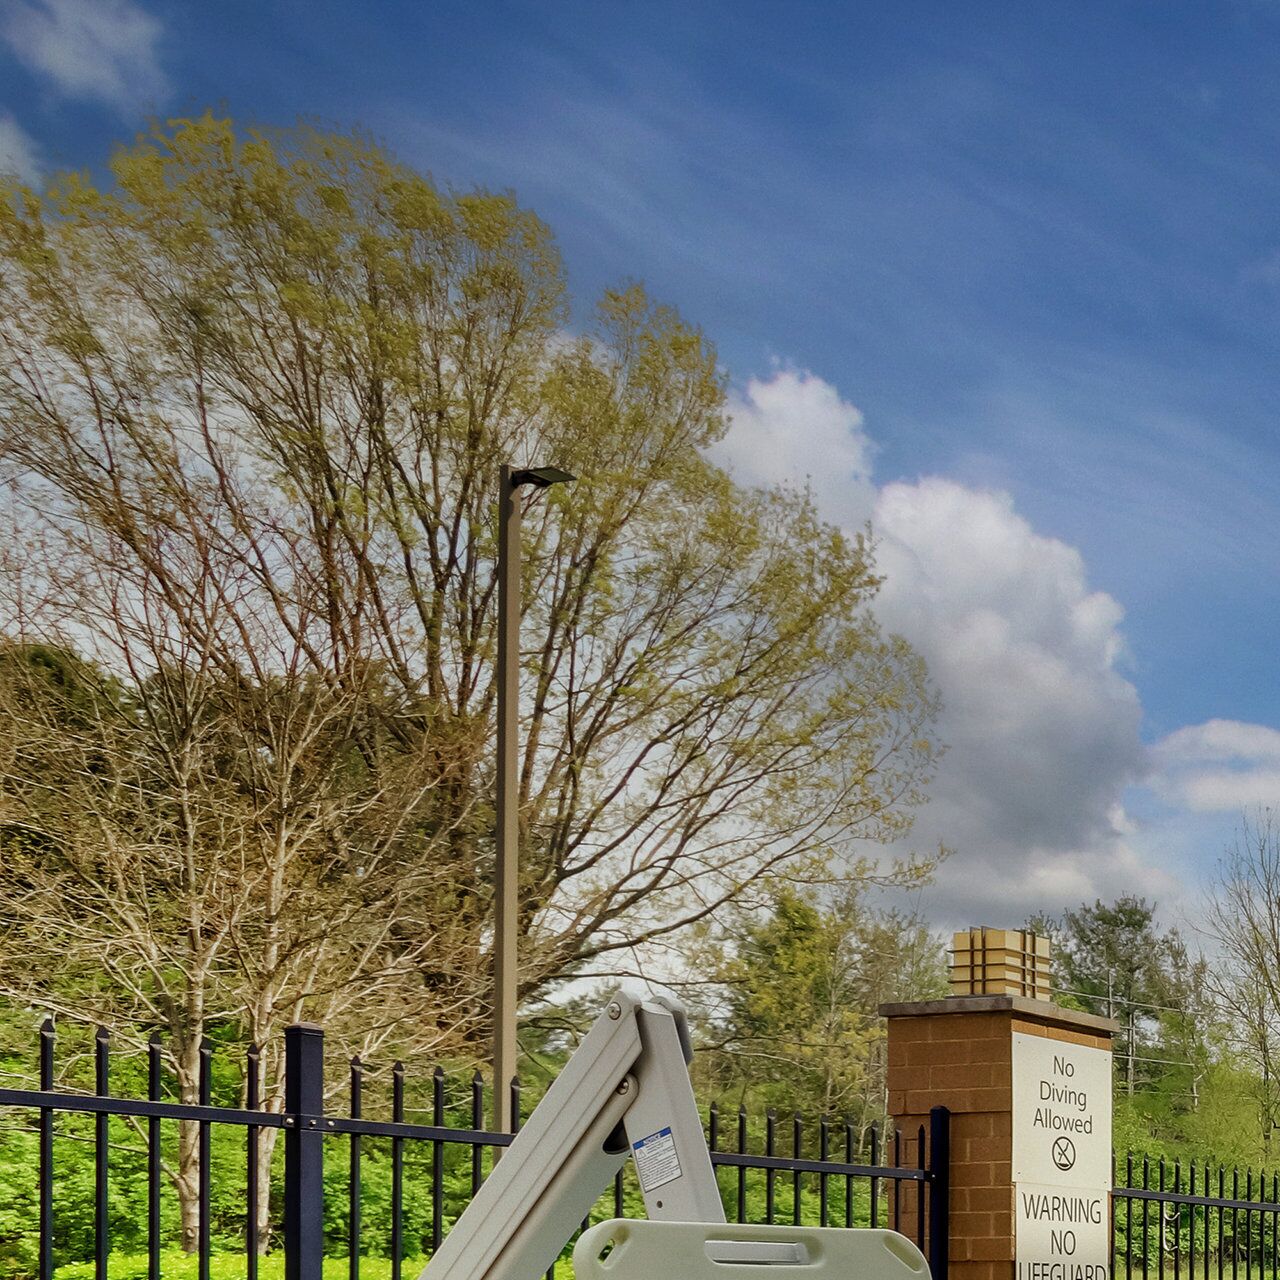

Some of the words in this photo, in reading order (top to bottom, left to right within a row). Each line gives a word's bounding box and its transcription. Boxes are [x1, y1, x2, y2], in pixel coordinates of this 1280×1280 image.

[1053, 1056, 1075, 1078] No
[1040, 1080, 1087, 1111] Diving
[1033, 1108, 1093, 1135] Allowed
[1022, 1192, 1102, 1225] WARNING
[1050, 1229, 1076, 1256] NO
